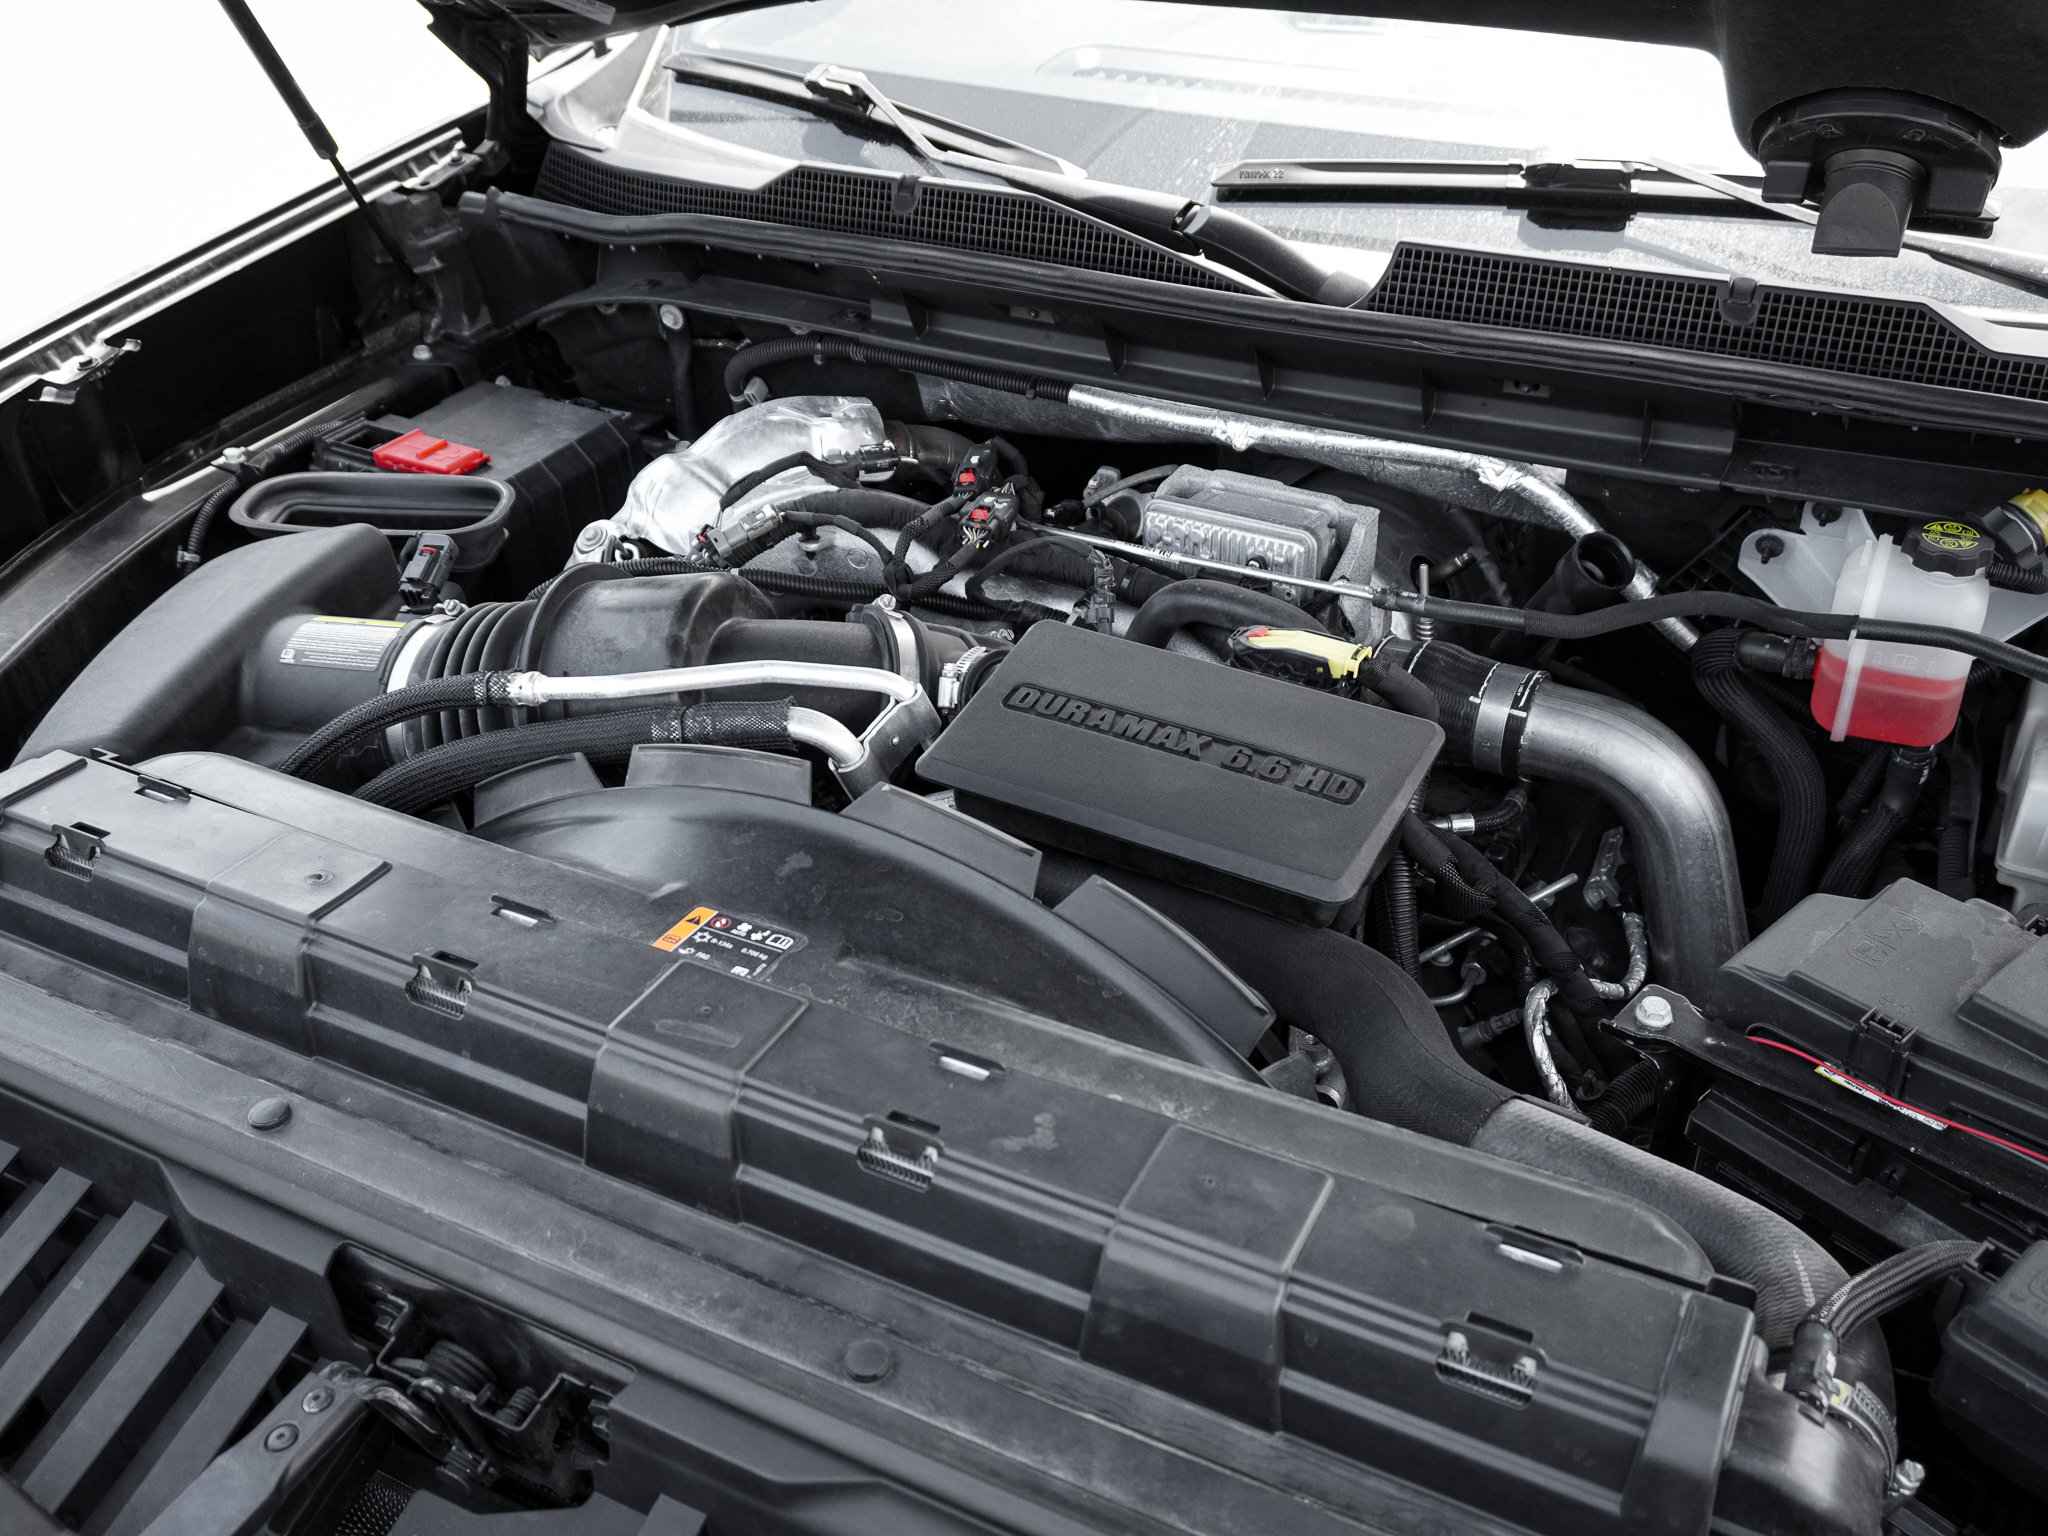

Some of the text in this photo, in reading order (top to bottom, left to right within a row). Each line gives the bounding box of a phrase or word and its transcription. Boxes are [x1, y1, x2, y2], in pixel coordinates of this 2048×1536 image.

[1006, 685, 1359, 804] DURAMAX 6.6 HD
